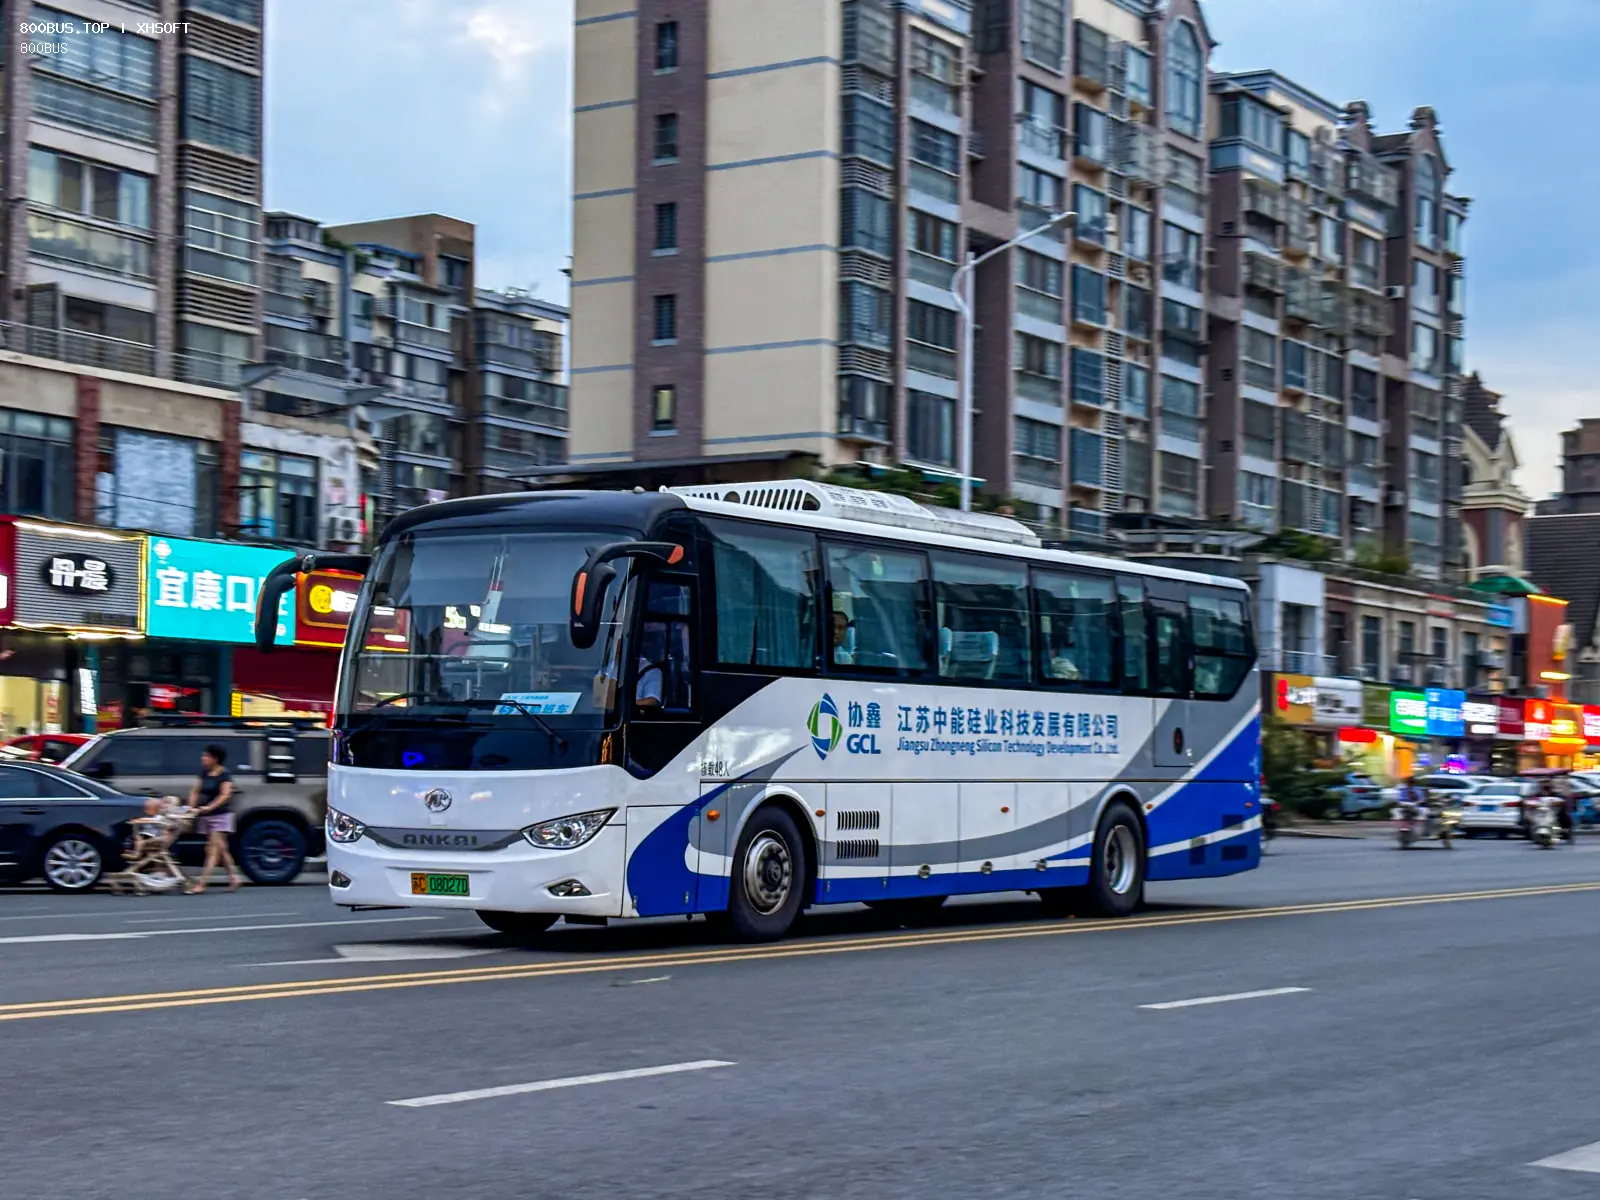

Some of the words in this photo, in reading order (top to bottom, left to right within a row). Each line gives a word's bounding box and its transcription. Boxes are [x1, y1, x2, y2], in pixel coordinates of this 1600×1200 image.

[848, 700, 881, 729] 协鑫
[897, 705, 1118, 739] 江苏中能硅业科技发展有限公司
[846, 734, 881, 754] GCL
[897, 736, 929, 755] Jiangsu
[930, 738, 976, 756] Zhongneng
[976, 739, 1002, 752] Silicon
[1003, 740, 1044, 756] Technology
[1047, 741, 1093, 757] Development
[403, 834, 478, 846] ANKAI
